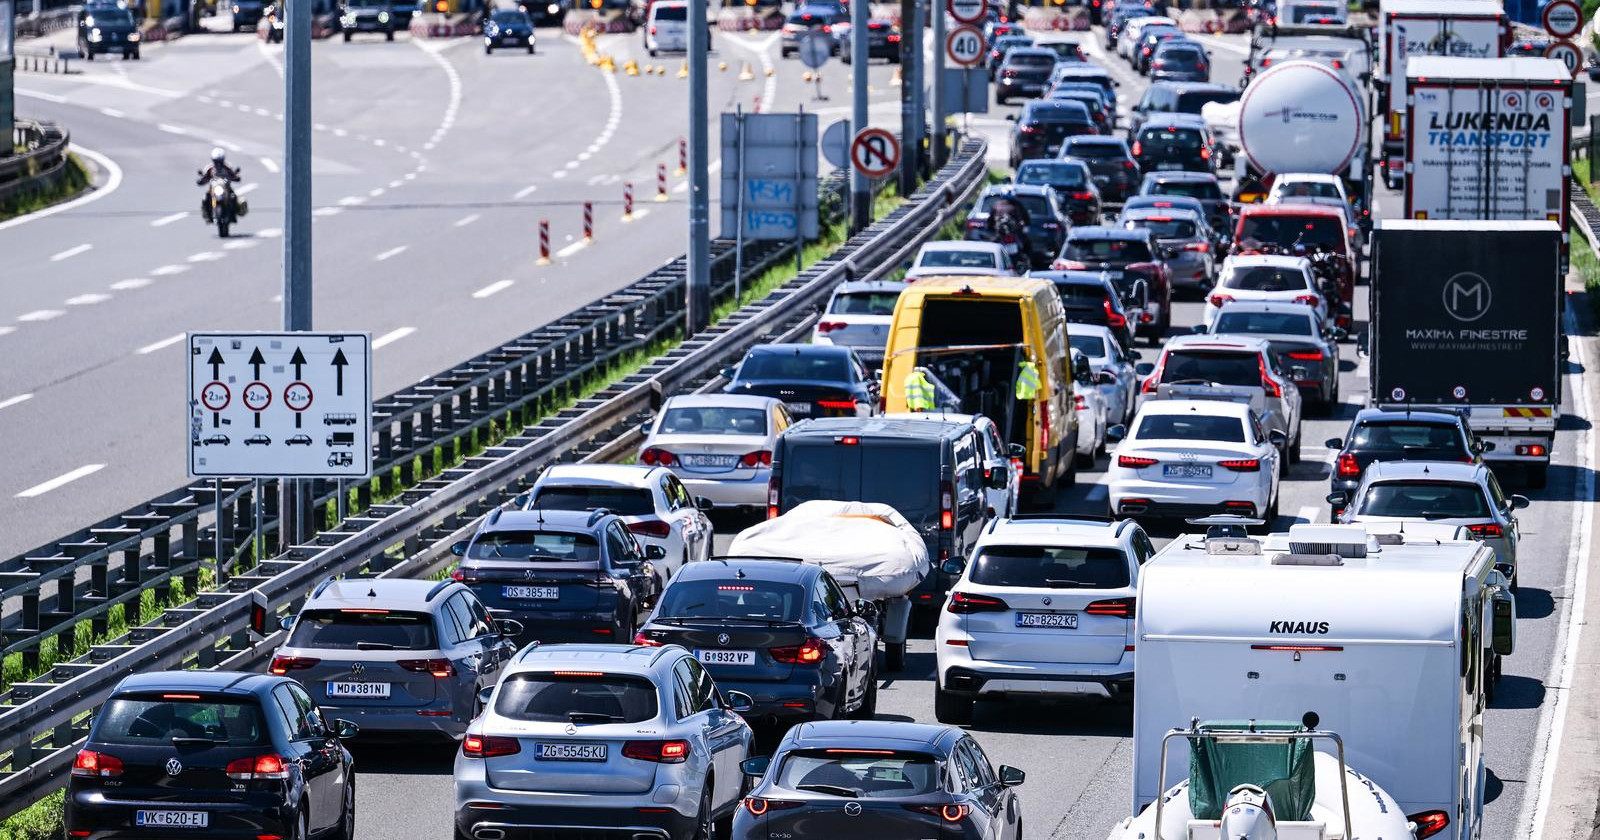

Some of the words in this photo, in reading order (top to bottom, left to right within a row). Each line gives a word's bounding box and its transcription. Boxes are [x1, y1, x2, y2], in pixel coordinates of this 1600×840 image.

[955, 37, 977, 54] 40
[1430, 112, 1550, 131] LUKENDA
[1428, 132, 1550, 148] TRANSPORT
[1406, 329, 1455, 339] MAXIMA
[1460, 330, 1528, 340] FINESTRE
[1393, 390, 1403, 398] 80
[508, 587, 519, 597] OS
[1023, 615, 1034, 625] ZG
[1269, 620, 1330, 634] KNAUS
[544, 745, 557, 757] ZG
[145, 812, 158, 823] VK
[166, 812, 206, 824] 620-EI
